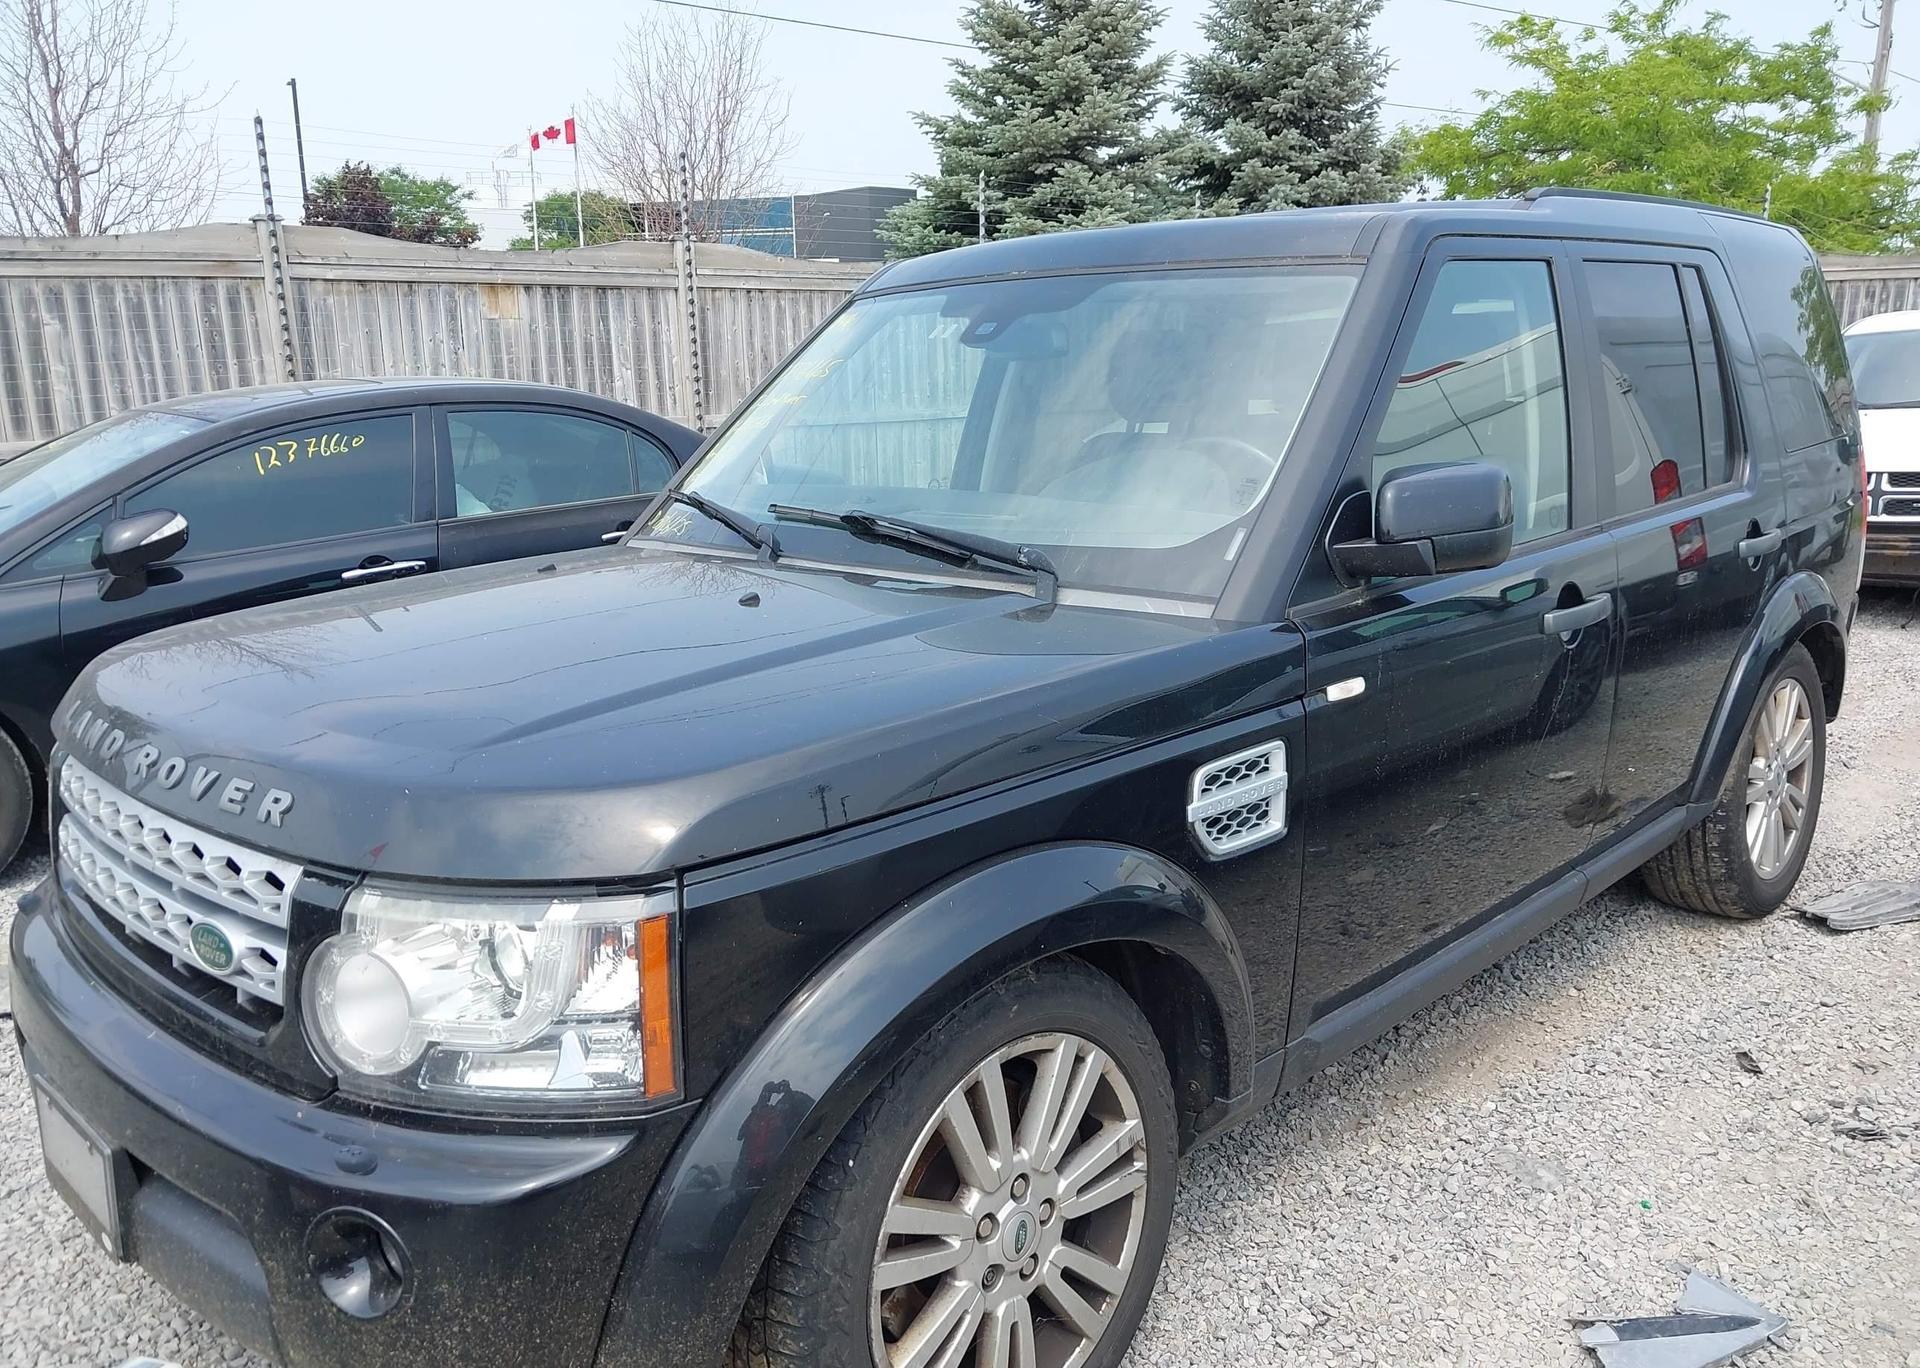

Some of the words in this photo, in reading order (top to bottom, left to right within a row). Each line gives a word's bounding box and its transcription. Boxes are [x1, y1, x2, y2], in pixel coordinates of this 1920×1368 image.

[254, 432, 365, 475] 12376660
[66, 699, 126, 760] LAND
[134, 743, 296, 829] ROVER
[1198, 798, 1236, 817] LAND
[1241, 780, 1284, 803] ROVER
[194, 943, 227, 965] ROVER
[198, 929, 220, 949] LAND
